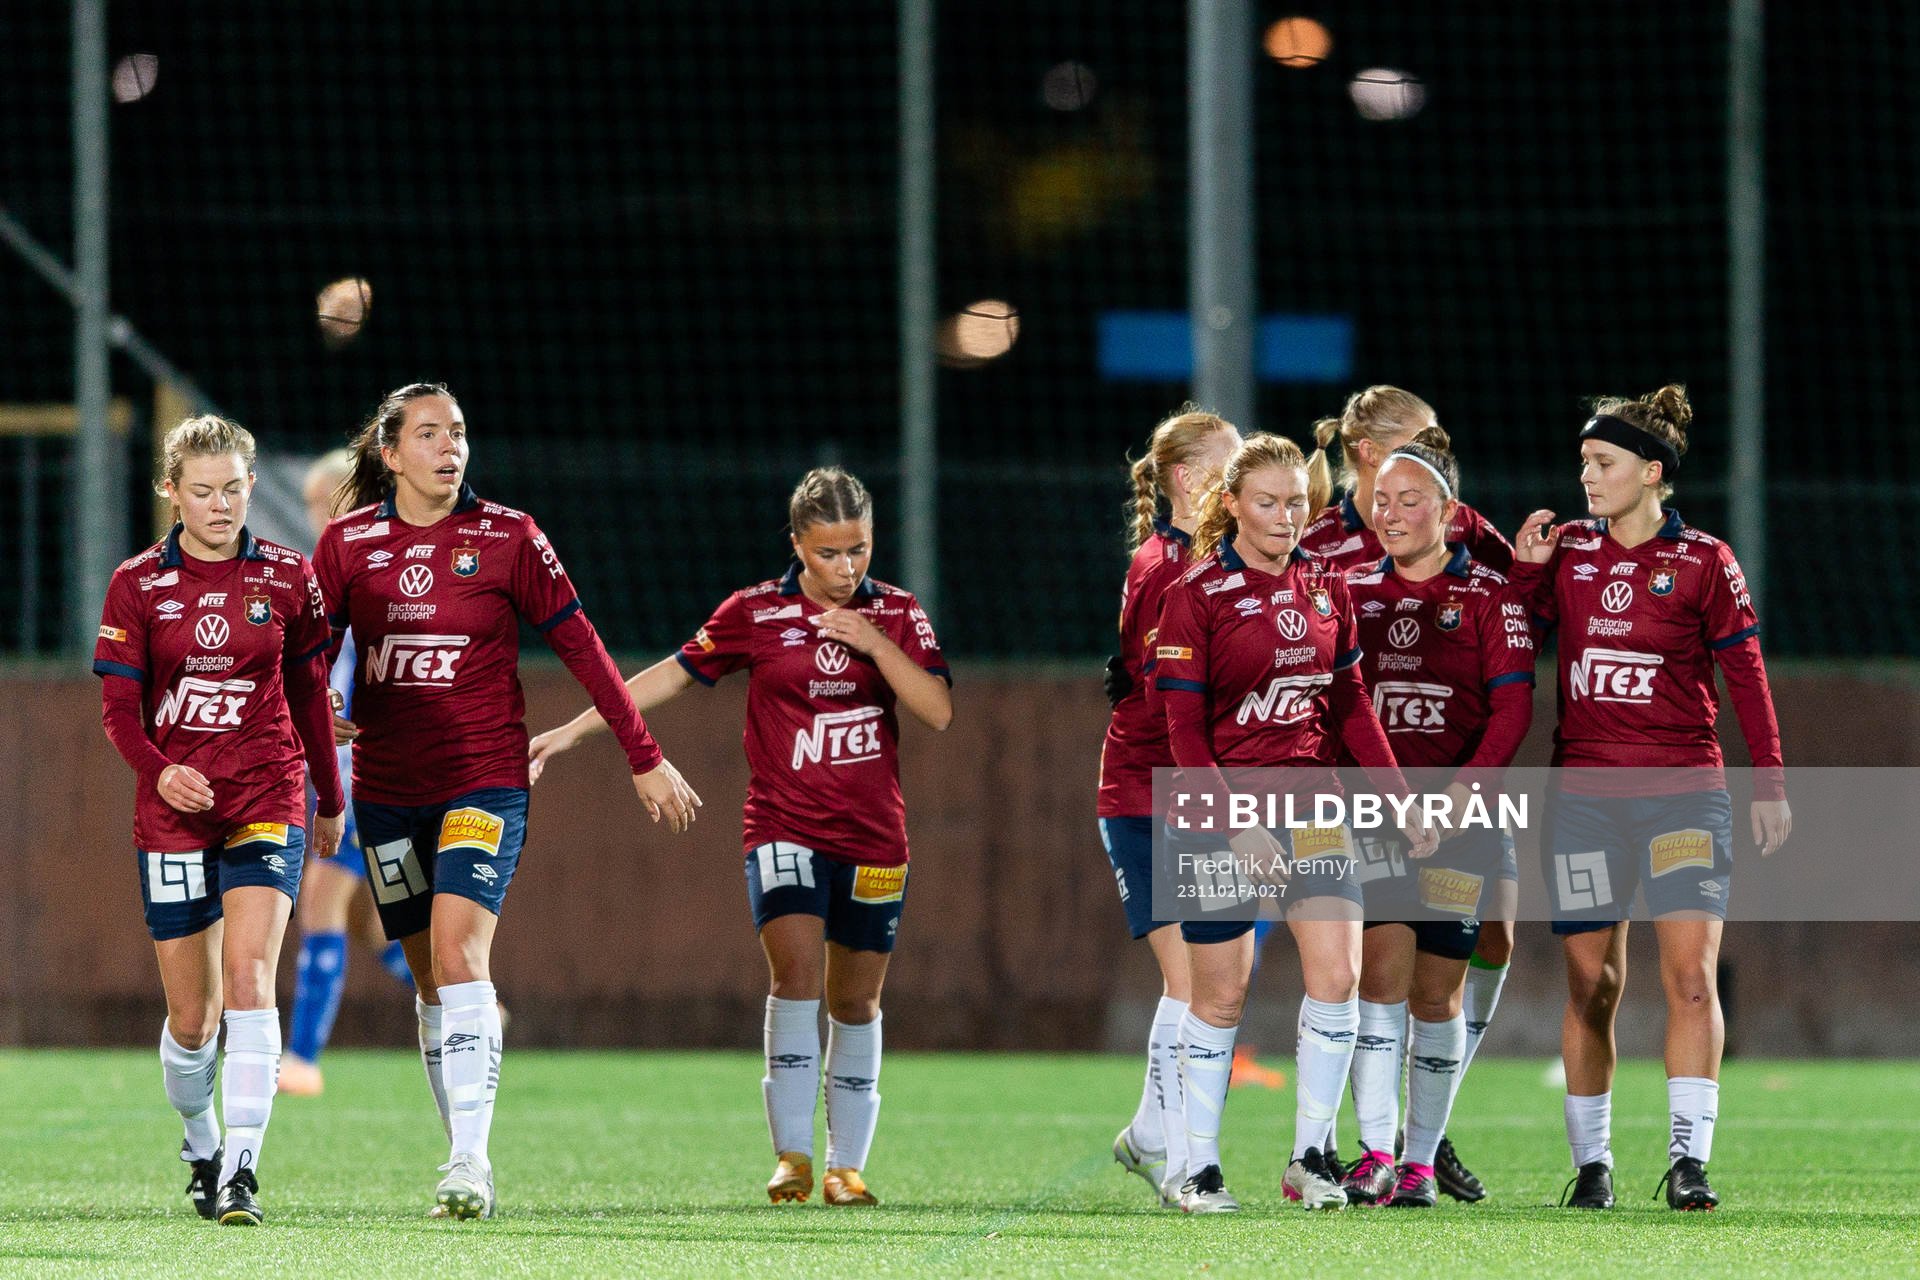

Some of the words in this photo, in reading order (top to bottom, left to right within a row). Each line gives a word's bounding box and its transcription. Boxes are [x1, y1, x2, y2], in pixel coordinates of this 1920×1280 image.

[458, 528, 482, 536] ERNST
[485, 531, 509, 539] ROSÉN
[264, 553, 279, 561] YGG
[405, 545, 436, 559] NTEX
[1656, 551, 1678, 559] ERNST
[1680, 554, 1702, 565] ROSÉN
[1609, 561, 1639, 575] NTEX
[269, 580, 292, 589] ROSÉN
[198, 593, 228, 607] NTEX
[1271, 590, 1294, 605] NTEX
[388, 602, 436, 613] factoring
[1395, 597, 1423, 613] NTEX
[1240, 608, 1262, 617] umbro
[1589, 616, 1633, 631] factoring
[1275, 646, 1316, 658] factoring
[1378, 652, 1422, 665] factoring
[186, 655, 234, 666] factoring
[366, 634, 470, 686] NTEX
[1570, 648, 1664, 700] NTEX
[809, 680, 856, 692] factoring
[155, 677, 256, 728] NTEX
[792, 706, 884, 770] NTEX
[446, 815, 498, 833] TRIUMF
[448, 827, 485, 839] GLASS
[1654, 837, 1709, 852] TRIUMF
[1662, 849, 1698, 860] GLASS
